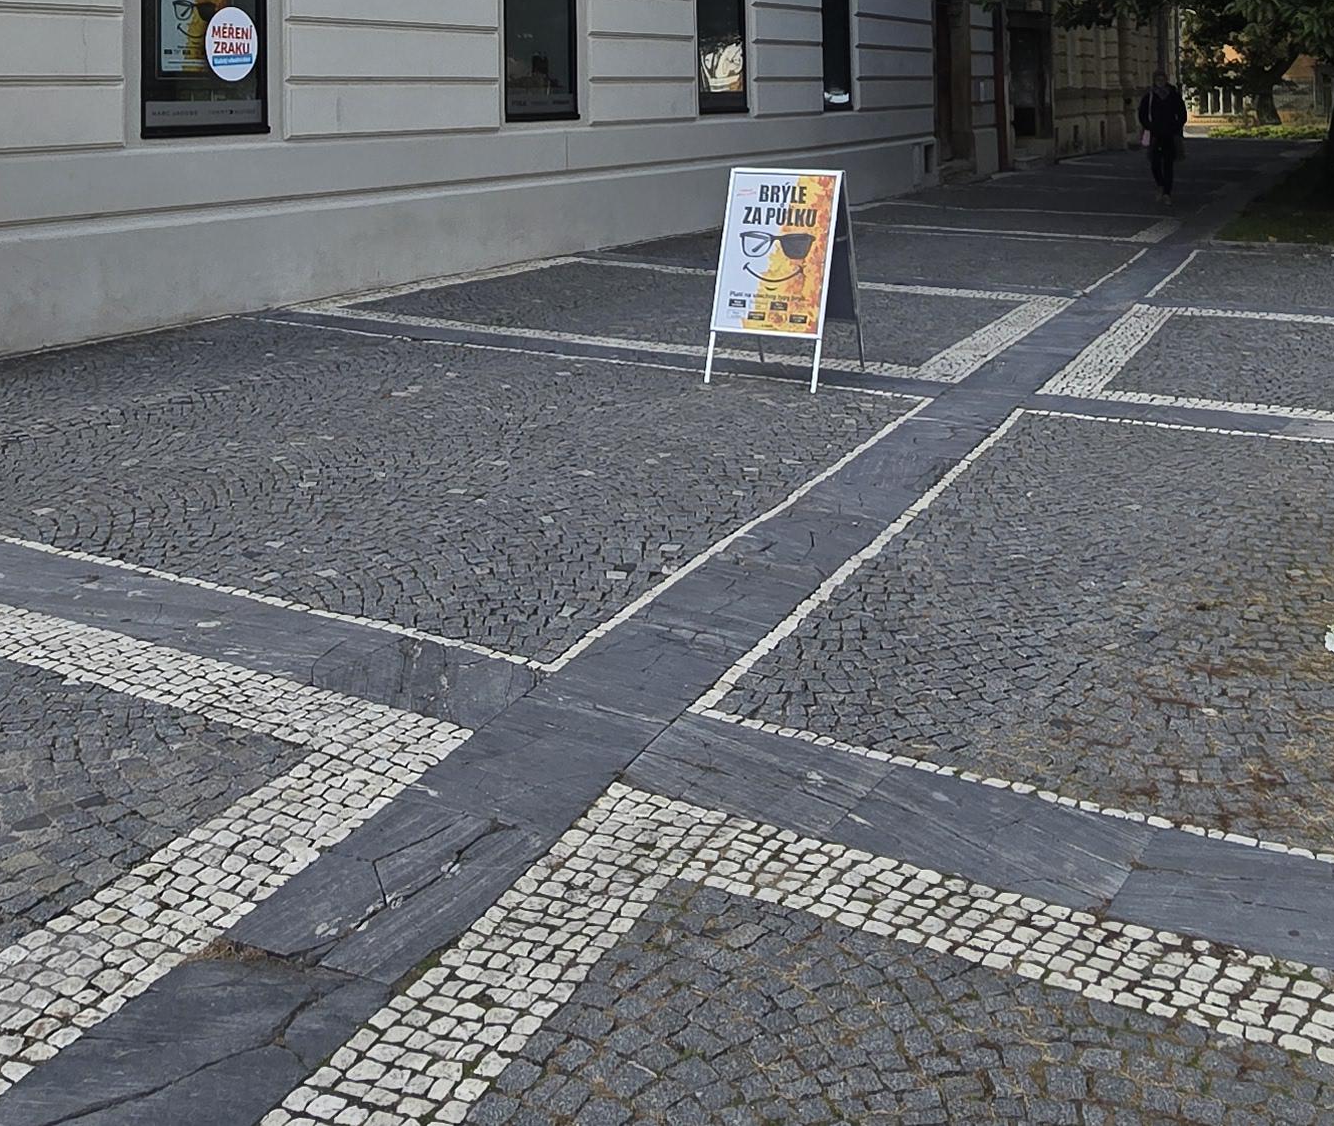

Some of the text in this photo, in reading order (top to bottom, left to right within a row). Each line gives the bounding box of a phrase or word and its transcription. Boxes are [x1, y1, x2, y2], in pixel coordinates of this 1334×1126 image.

[211, 23, 253, 40] MĚŘENÍ
[213, 41, 250, 55] ZRAKU
[758, 182, 807, 204] BRÝLE
[742, 203, 818, 228] ZA PŮLKU
